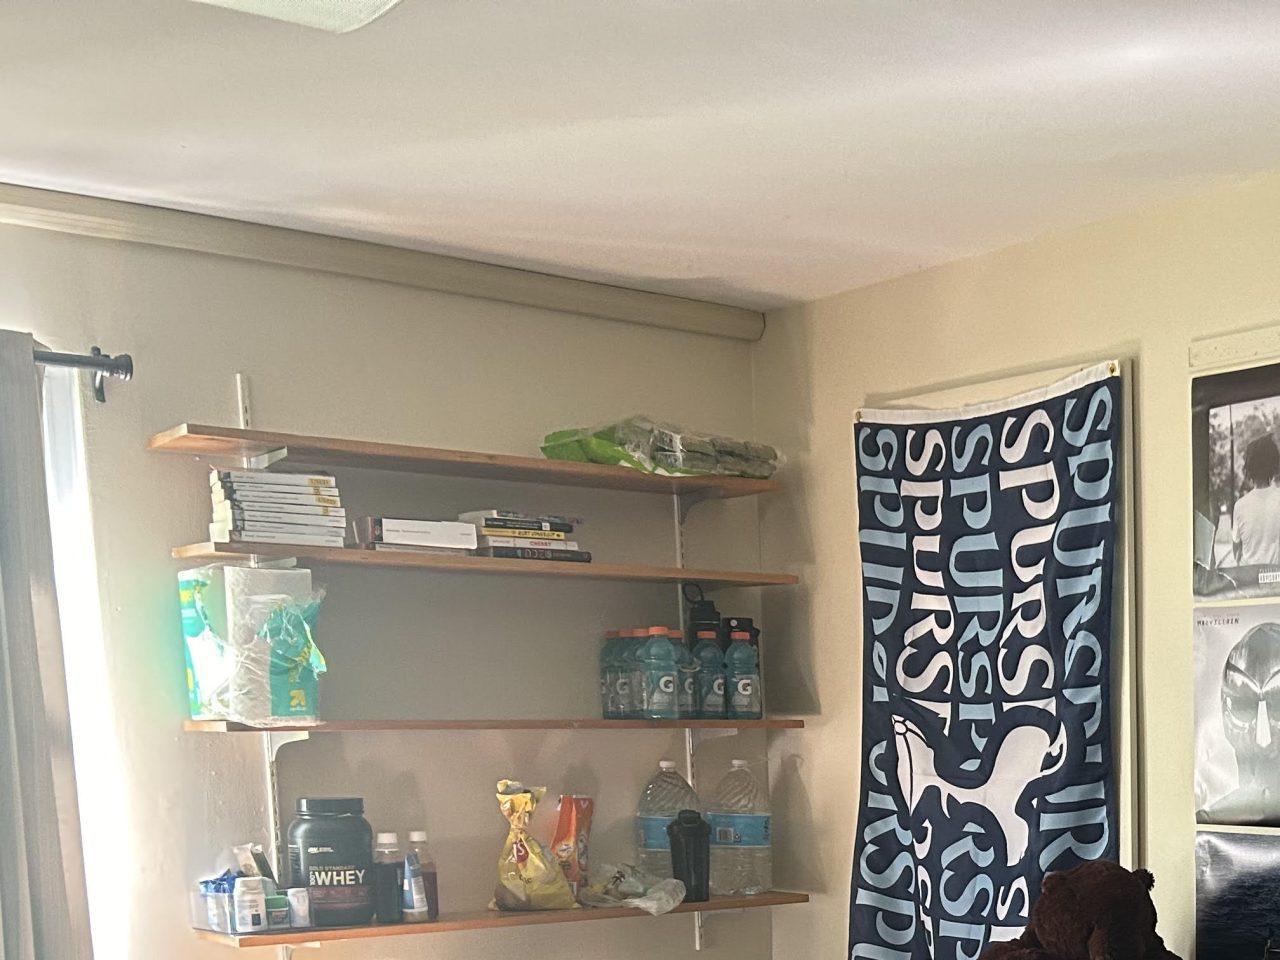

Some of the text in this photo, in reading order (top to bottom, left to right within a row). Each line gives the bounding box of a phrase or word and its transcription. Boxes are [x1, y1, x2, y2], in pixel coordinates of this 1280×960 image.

[659, 675, 674, 693] G
[713, 678, 725, 695] G
[737, 678, 752, 695] G
[314, 869, 366, 886] WHEY
